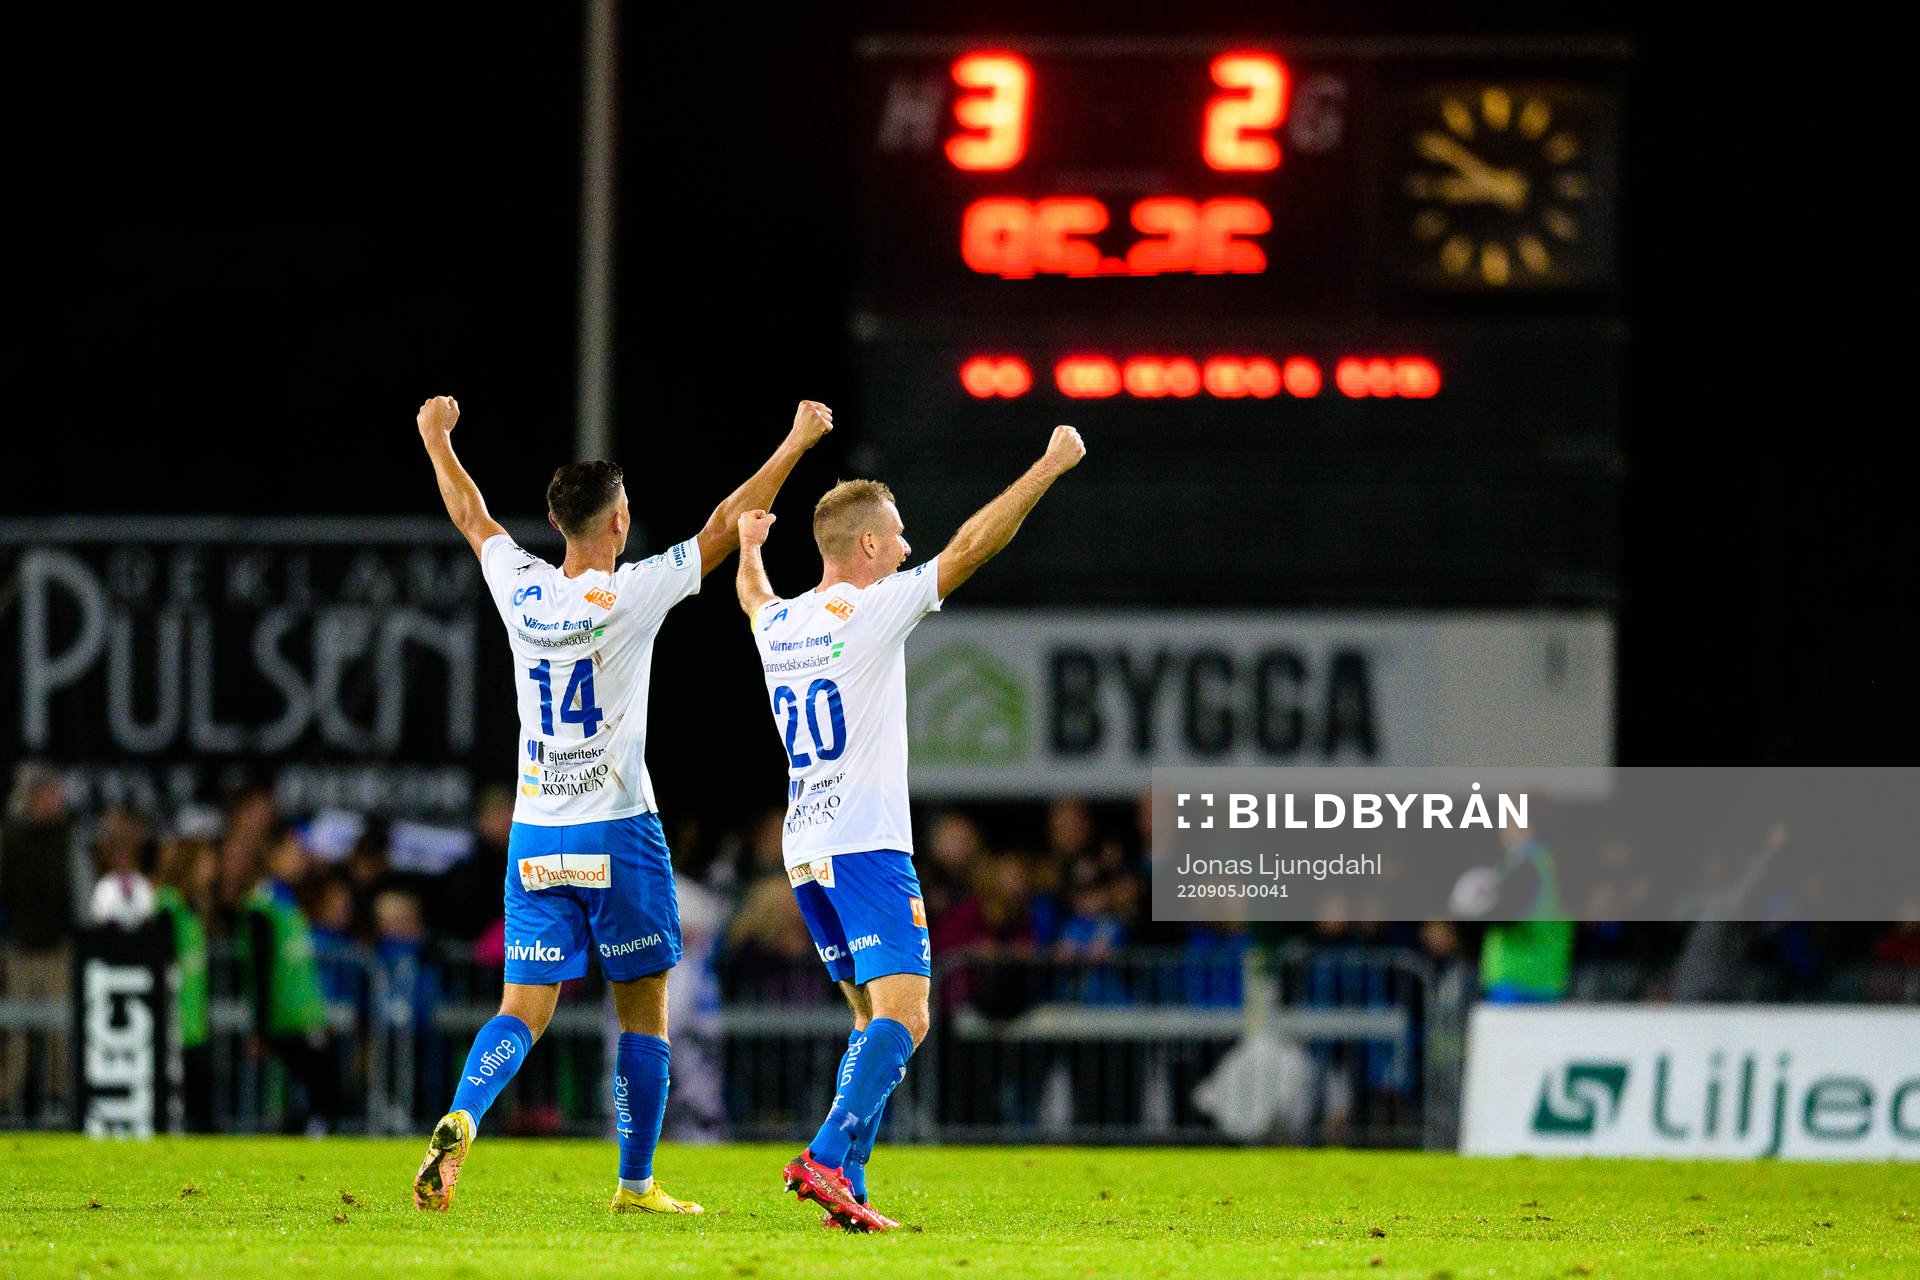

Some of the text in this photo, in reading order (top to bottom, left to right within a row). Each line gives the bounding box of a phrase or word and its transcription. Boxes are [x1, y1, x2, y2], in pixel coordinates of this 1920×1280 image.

[946, 50, 1031, 172] 3
[1203, 50, 1290, 172] 2
[522, 614, 593, 631] Värnamo Energi
[806, 632, 832, 647] Energi
[764, 656, 830, 672] innvedsbostäder
[529, 658, 604, 739] 14
[1045, 642, 1383, 762] BYGGA
[774, 678, 847, 768] 20
[542, 777, 605, 796] KOMMUN
[534, 864, 606, 883] Pinewood
[612, 933, 662, 956] RAVEMA
[466, 1039, 516, 1087] 4 office
[613, 1075, 633, 1139] 4 office
